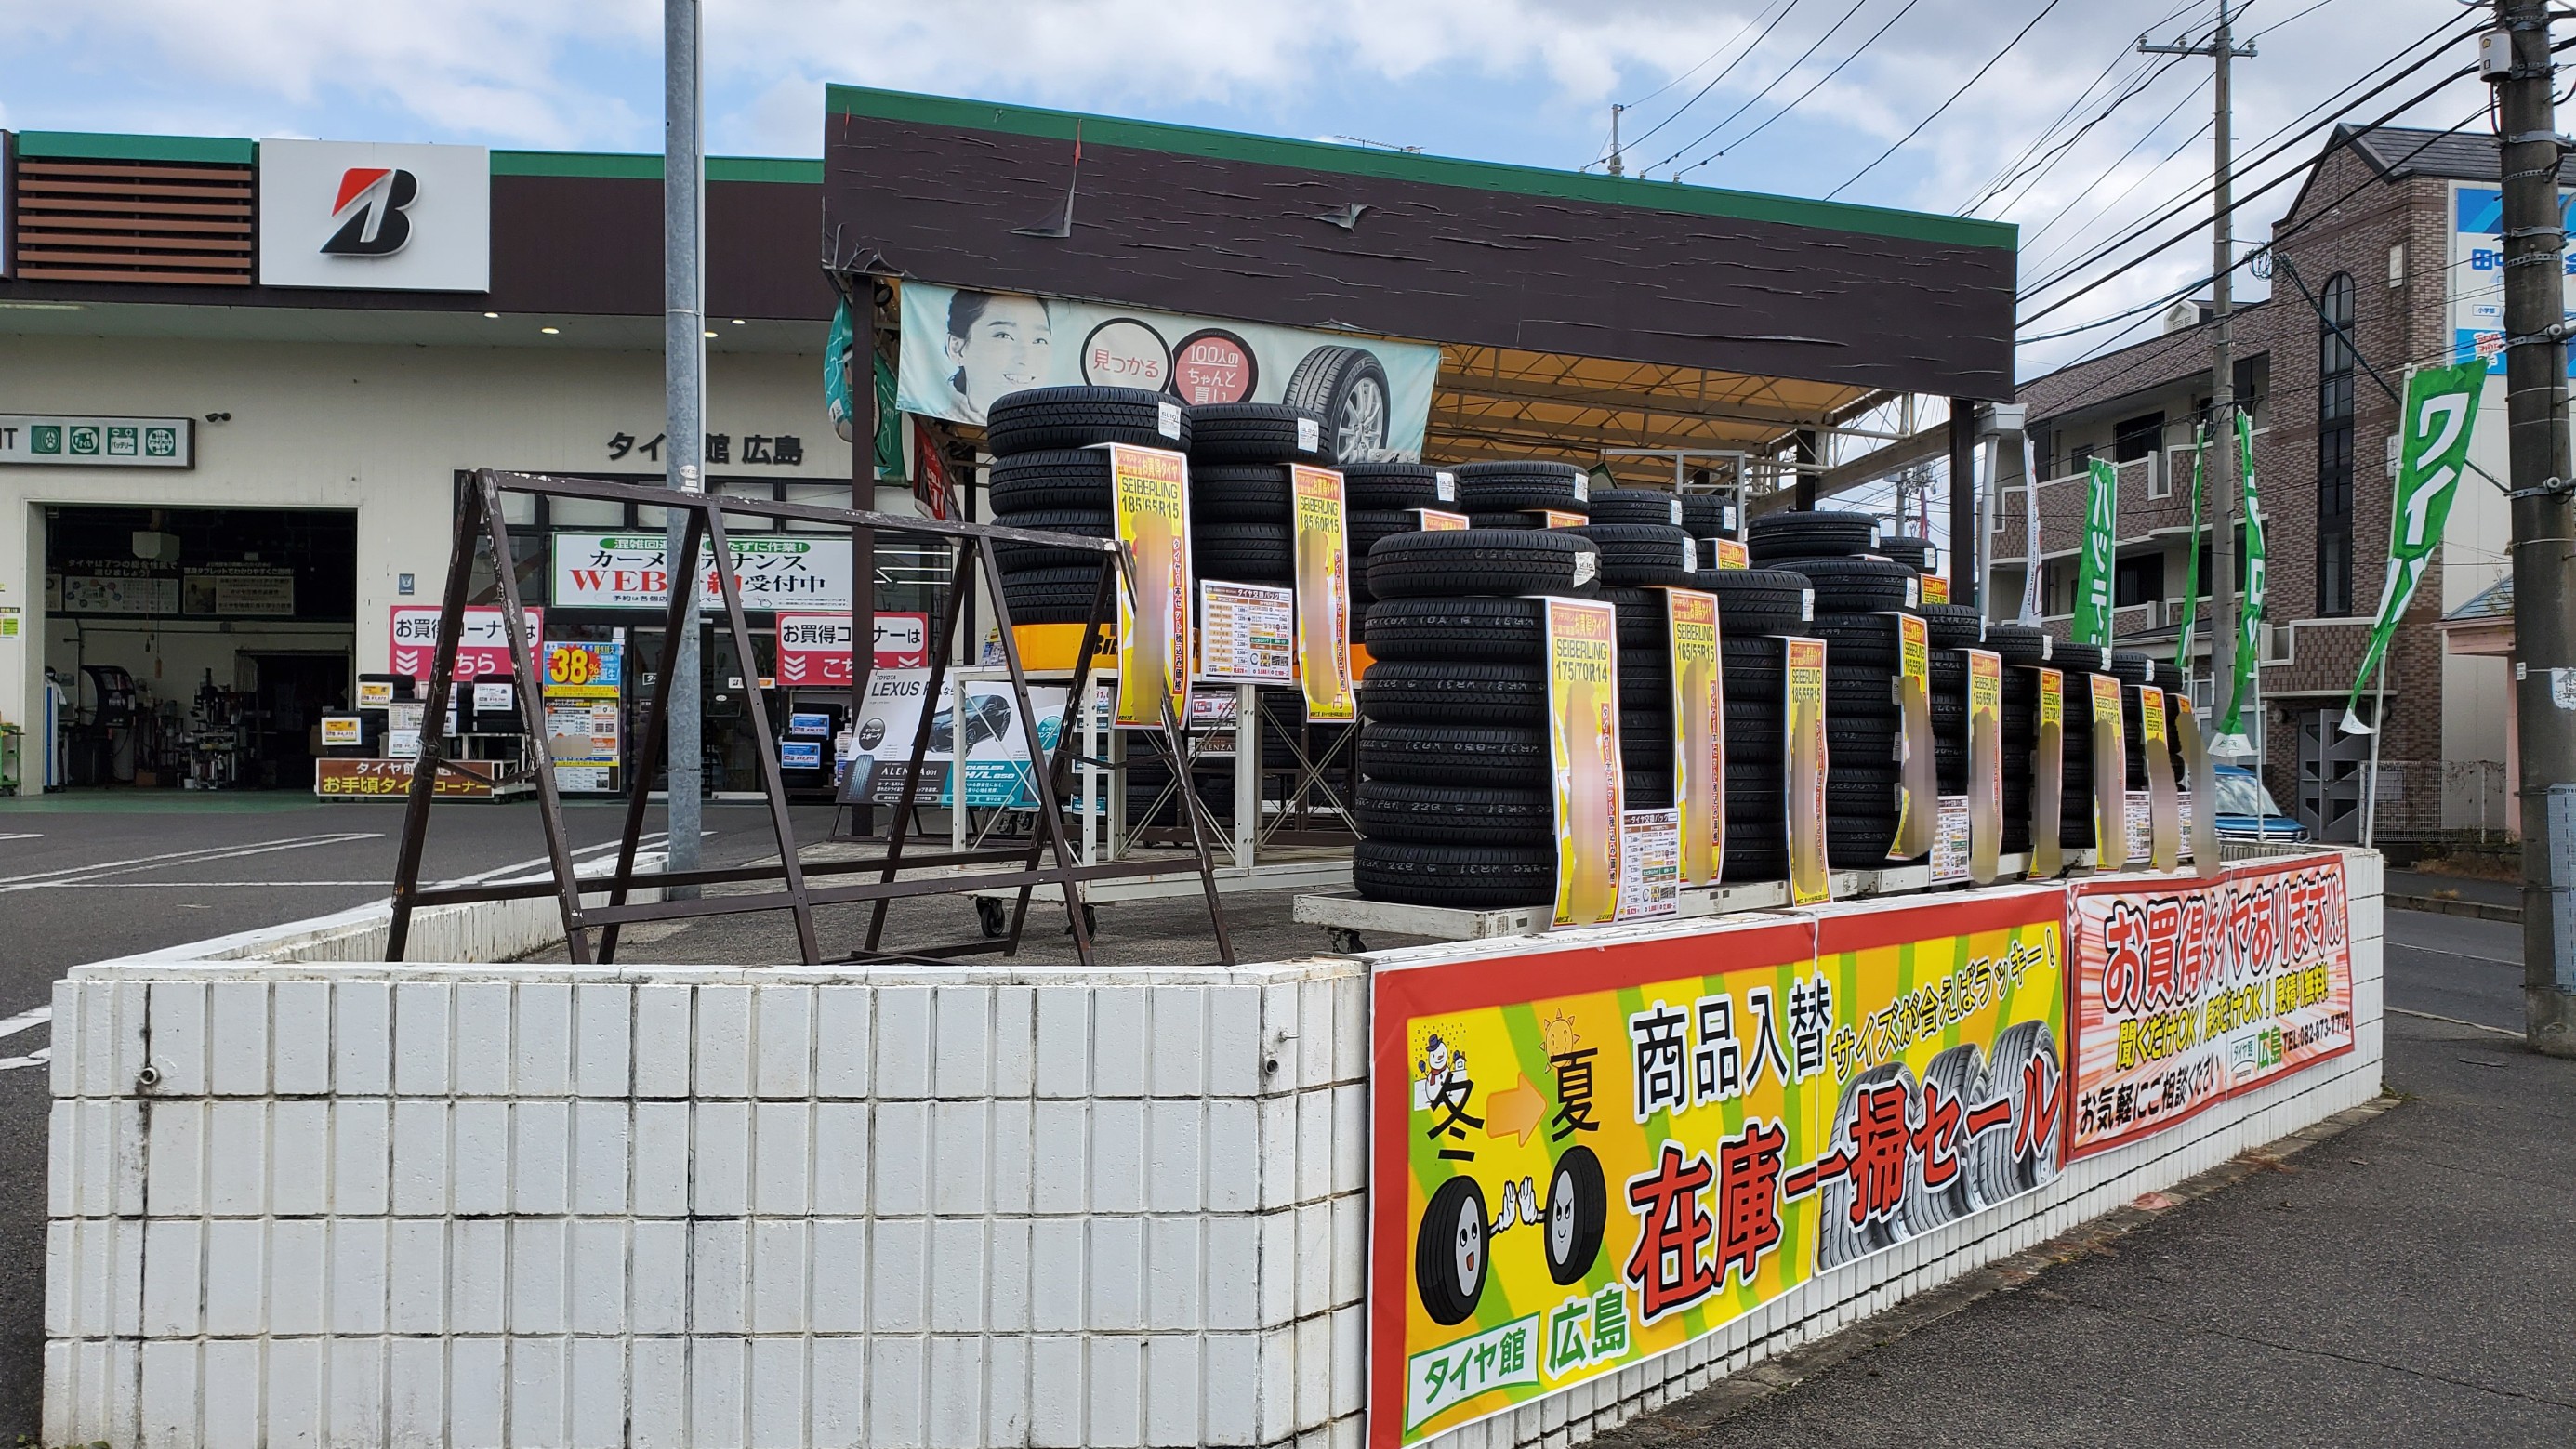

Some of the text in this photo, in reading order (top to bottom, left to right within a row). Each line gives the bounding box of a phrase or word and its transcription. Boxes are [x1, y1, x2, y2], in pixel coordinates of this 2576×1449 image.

[1093, 348, 1159, 378] 見つかる
[1189, 345, 1239, 363] 100人の
[1188, 368, 1236, 388] ちゃんと
[607, 432, 803, 465] タイ館 広島
[1121, 477, 1178, 499] SEIBERLING
[1121, 495, 1180, 519] 185/65R15
[1300, 496, 1339, 516] SEIBERLING
[1300, 512, 1340, 534] 185/60R15
[1237, 589, 1280, 599] タイヤ交換パック
[783, 624, 921, 645] お買得コナーは
[1676, 623, 1713, 642] SEIBERLING
[1556, 639, 1607, 660] SEIBERLING
[550, 649, 588, 685] 38
[588, 663, 600, 675] %
[1556, 663, 1608, 682] 175/70R14
[1791, 668, 1821, 686] SEIBERLING
[587, 674, 600, 684] OFF
[871, 681, 920, 696] LEXUS
[881, 767, 925, 776] ALENA
[324, 776, 491, 794] お手頃タイコーナー
[1631, 814, 1668, 824] タイヤ交換パック
[1632, 978, 1830, 1115] 商品入替
[2257, 1024, 2282, 1070] 広島
[1550, 1047, 1600, 1143] 夏
[2079, 1051, 2221, 1135] お気軽にご相談ください
[1427, 1074, 1485, 1162] 冬
[1628, 1057, 2062, 1317] 在庫一掃セール
[1424, 1290, 1627, 1405] タイヤ館 広島
